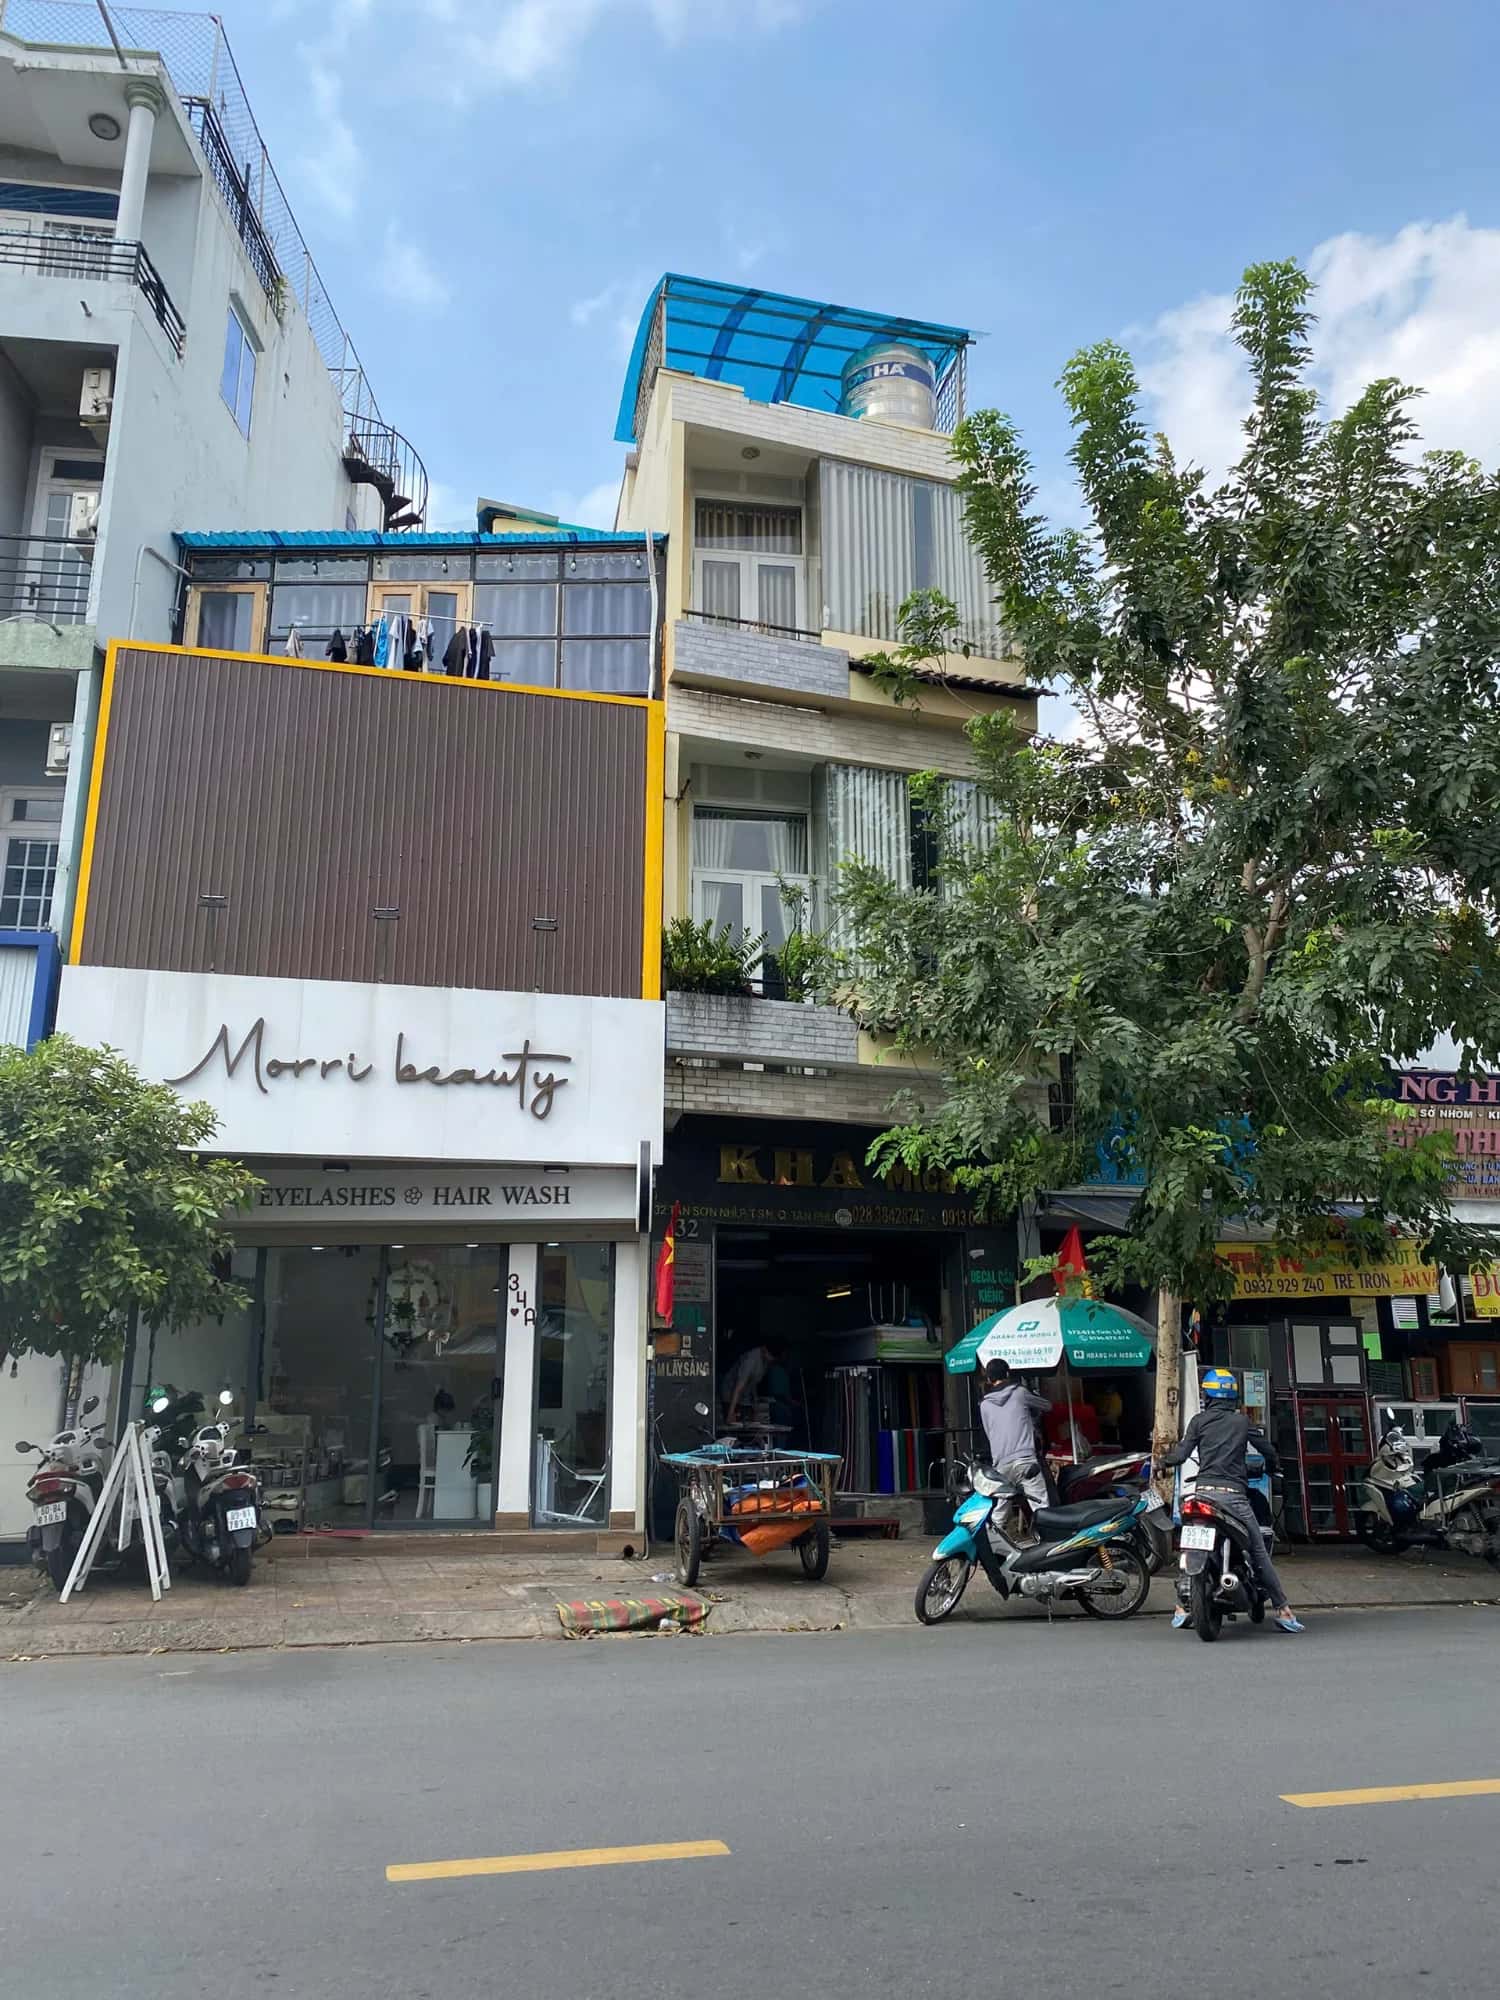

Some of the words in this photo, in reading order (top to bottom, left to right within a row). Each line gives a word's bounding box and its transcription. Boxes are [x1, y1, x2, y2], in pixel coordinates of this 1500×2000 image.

[163, 1017, 373, 1094] Morri
[395, 1032, 572, 1120] beauty
[716, 1144, 866, 1189] KHA
[259, 1187, 396, 1207] EYELASHES
[432, 1186, 492, 1205] HAIR
[502, 1185, 571, 1205] WASH
[673, 1217, 699, 1238] 32
[1243, 1278, 1274, 1295] 0932
[1277, 1278, 1299, 1293] 929
[1303, 1277, 1325, 1292] 240
